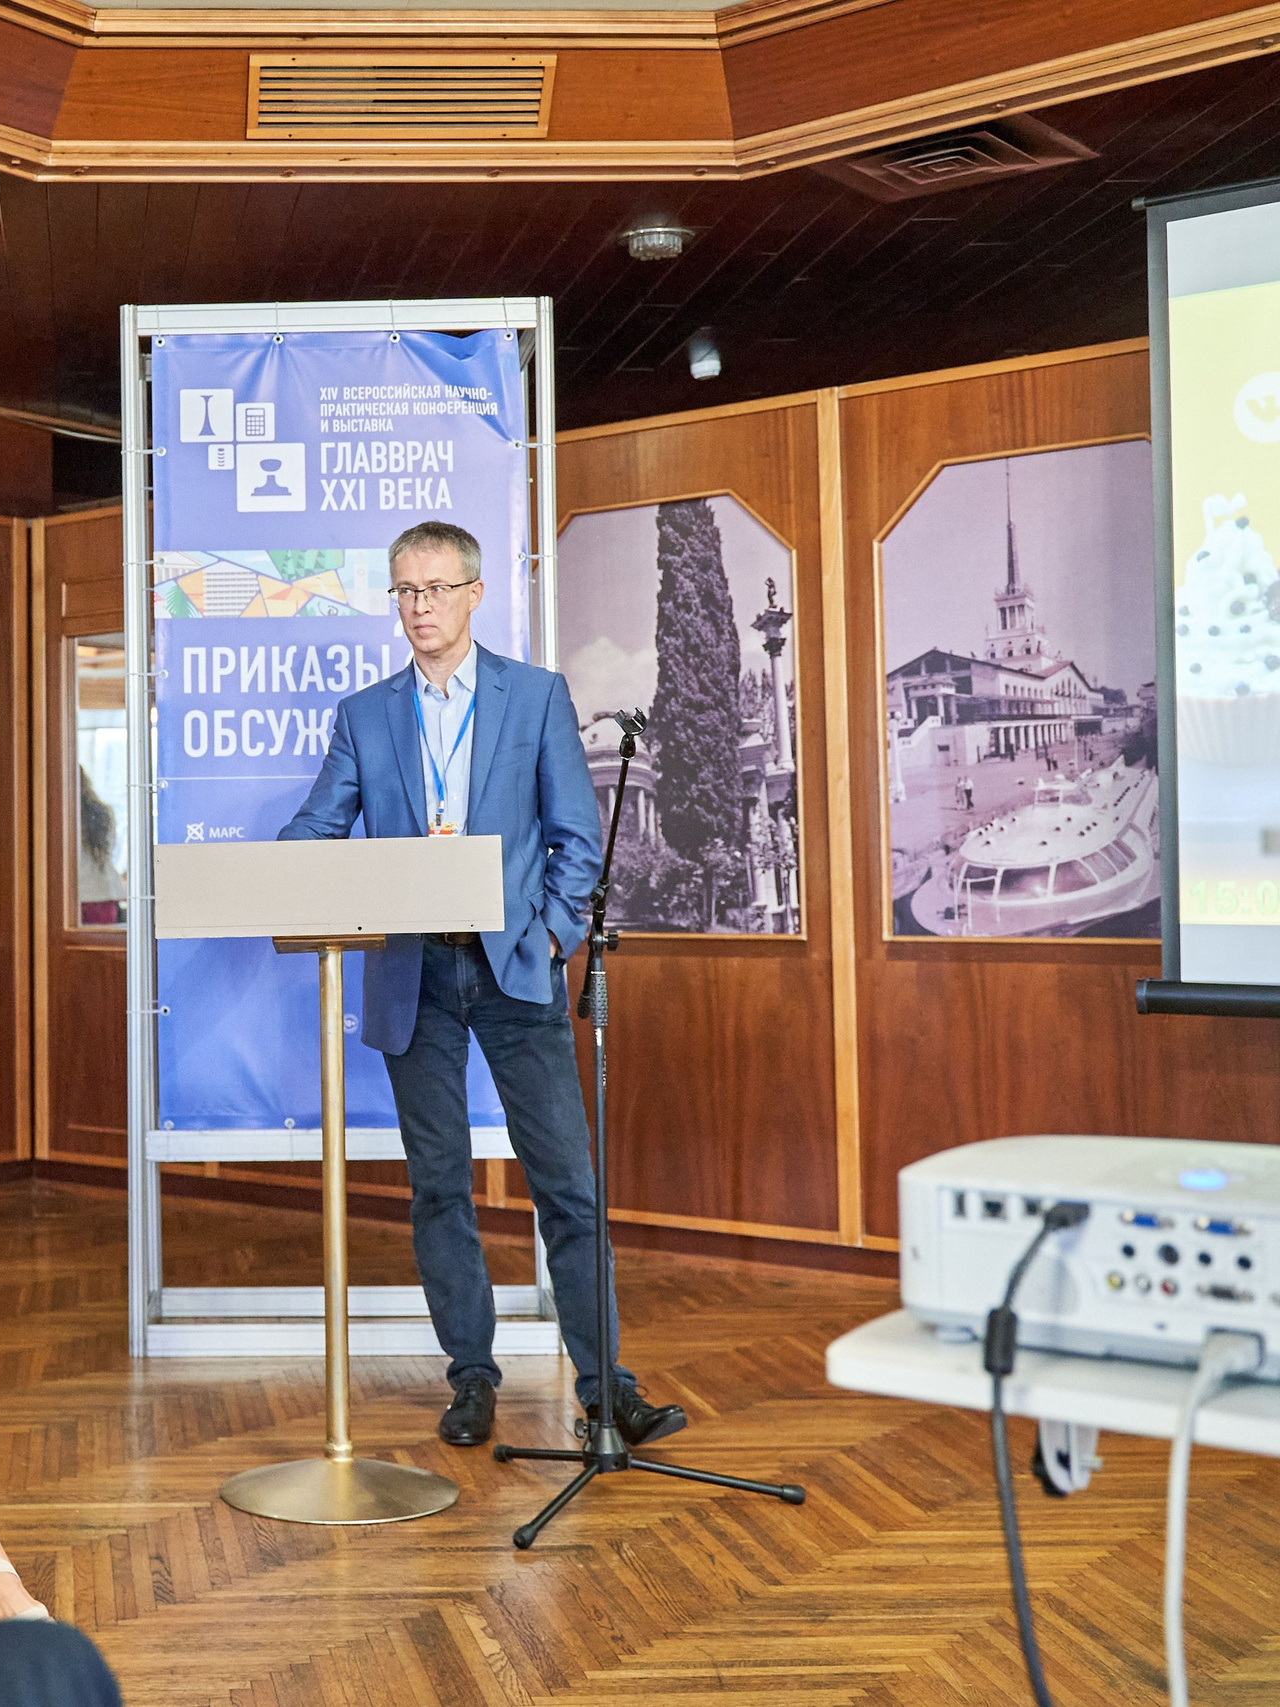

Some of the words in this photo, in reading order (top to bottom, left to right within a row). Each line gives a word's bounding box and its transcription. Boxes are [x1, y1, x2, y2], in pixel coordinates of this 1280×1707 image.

[343, 383, 441, 400] ВСЕРОССИЙСКАЯ
[445, 385, 493, 400] НАУЧНО-
[320, 402, 408, 418] ПРАКТИЧЕСКАЯ
[413, 401, 498, 416] КОНФЕРЕНЦИЯ
[320, 419, 329, 433] И
[333, 418, 394, 433] ВЫСТАВКА
[320, 440, 454, 474] ГЛАВВРАЧ
[378, 477, 453, 511] ВЕКА
[183, 645, 390, 694] ПРИКАЗЫ
[209, 827, 245, 839] МАРС
